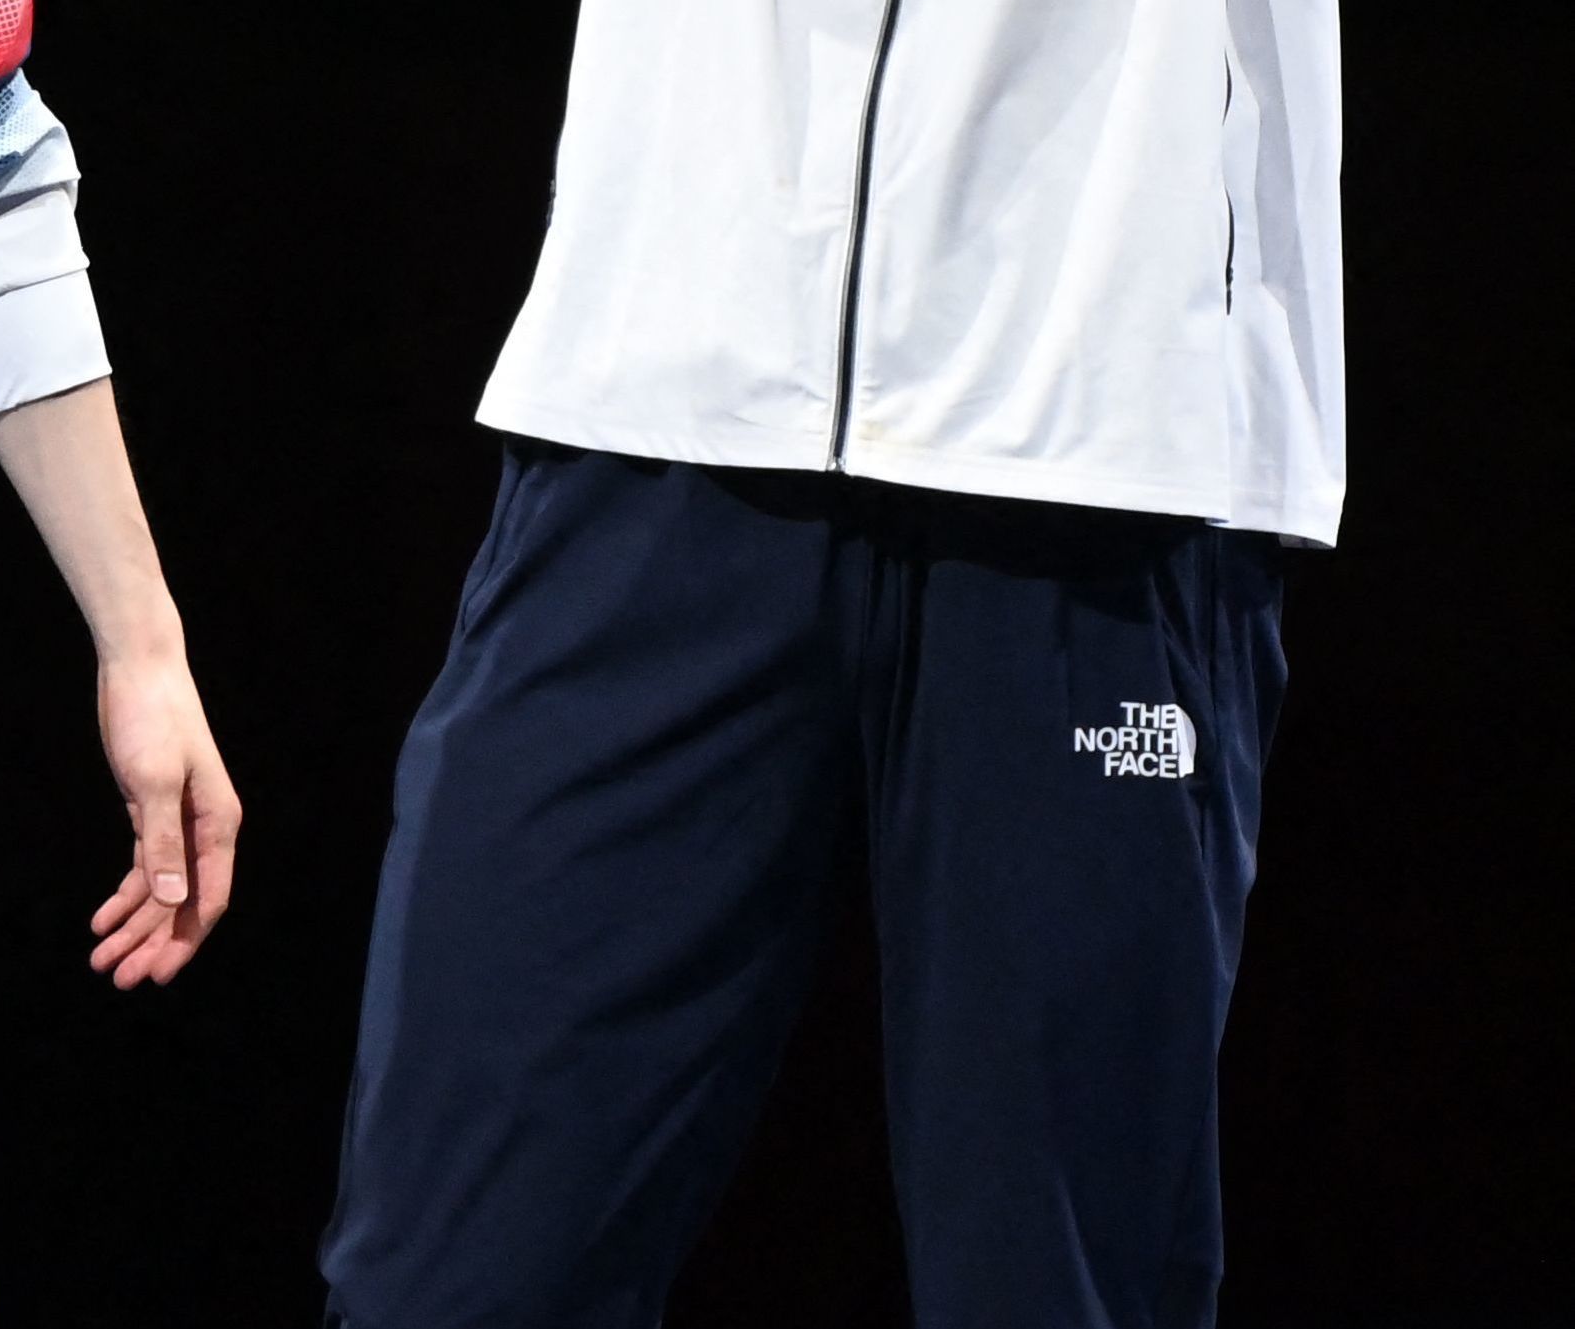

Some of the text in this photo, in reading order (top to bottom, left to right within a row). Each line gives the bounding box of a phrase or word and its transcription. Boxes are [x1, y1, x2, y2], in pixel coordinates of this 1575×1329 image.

[1119, 701, 1178, 729] THE
[1074, 726, 1179, 754] NORTH
[1104, 750, 1178, 779] FACE
